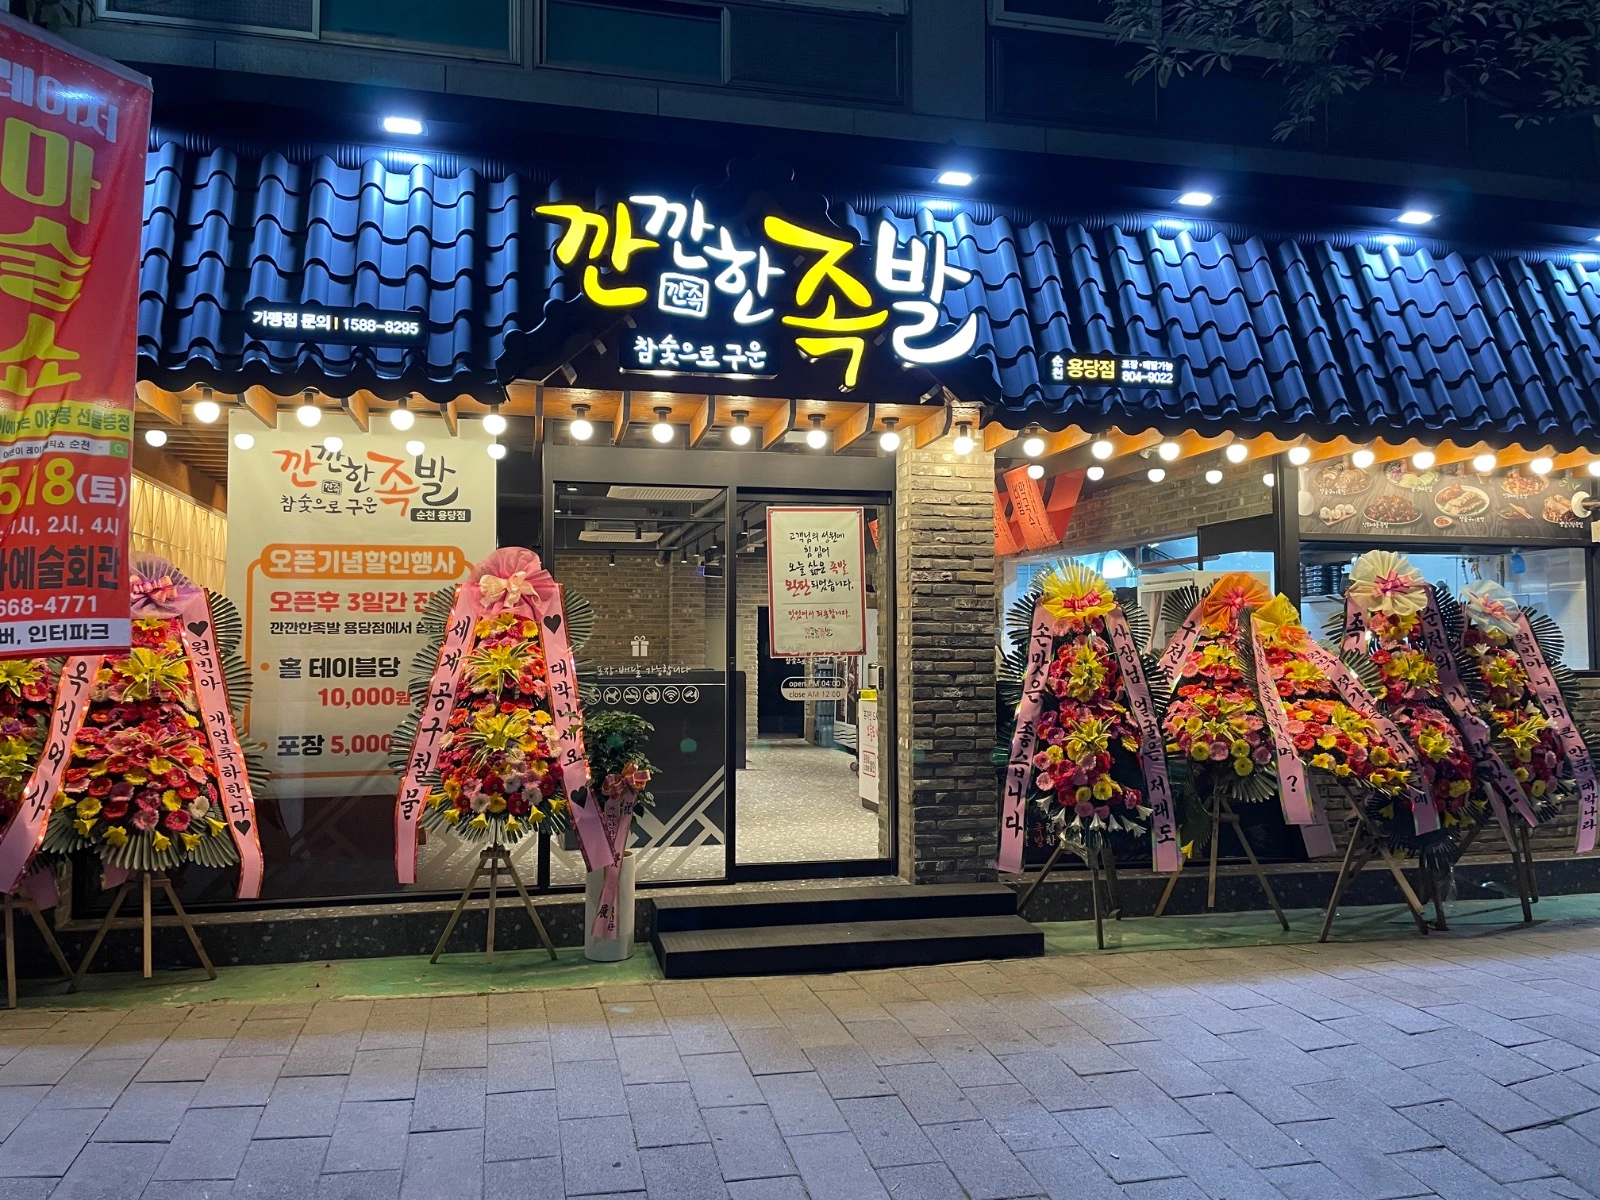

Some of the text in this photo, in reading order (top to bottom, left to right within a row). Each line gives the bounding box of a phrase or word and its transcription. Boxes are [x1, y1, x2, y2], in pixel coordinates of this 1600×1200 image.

[252, 311, 419, 335] 가맹점 문의 1588-8295
[721, 341, 767, 370] 구운
[1067, 357, 1116, 380] 용당점
[1121, 370, 1174, 384] 804-9022
[69, 439, 91, 451] 순천
[345, 497, 378, 517] 구운
[415, 510, 467, 522] 순천 용당점
[47, 515, 84, 535] 2시,
[90, 517, 120, 537] 4시
[269, 549, 457, 575] 오픈기념할인행사
[788, 560, 807, 577] 오늘
[829, 559, 849, 577] 족발
[269, 591, 340, 614] 오픈후
[346, 591, 408, 614] 3일간
[28, 622, 110, 644] 인터파크
[269, 621, 341, 636] 깐깐한족발
[343, 621, 413, 636] 용당점에서
[190, 639, 221, 691] 원빈아
[1024, 622, 1052, 704] 손맛은
[1112, 623, 1143, 685] 사장님
[278, 656, 401, 680] 홀 테이블당
[788, 681, 806, 689] open
[807, 680, 819, 688] PM
[788, 690, 806, 699] close
[807, 690, 820, 699] AM
[317, 686, 412, 709] 10,000원
[1448, 686, 1479, 726] 가장
[1515, 632, 1544, 669] 원빈아
[1542, 694, 1565, 721] 머리
[1559, 728, 1576, 740] 큰
[1568, 745, 1590, 774] 만큼
[549, 658, 584, 767] 대박나세요
[276, 734, 326, 757] 포장
[208, 710, 250, 819] 개업축하한다
[1149, 775, 1177, 845] 저래도
